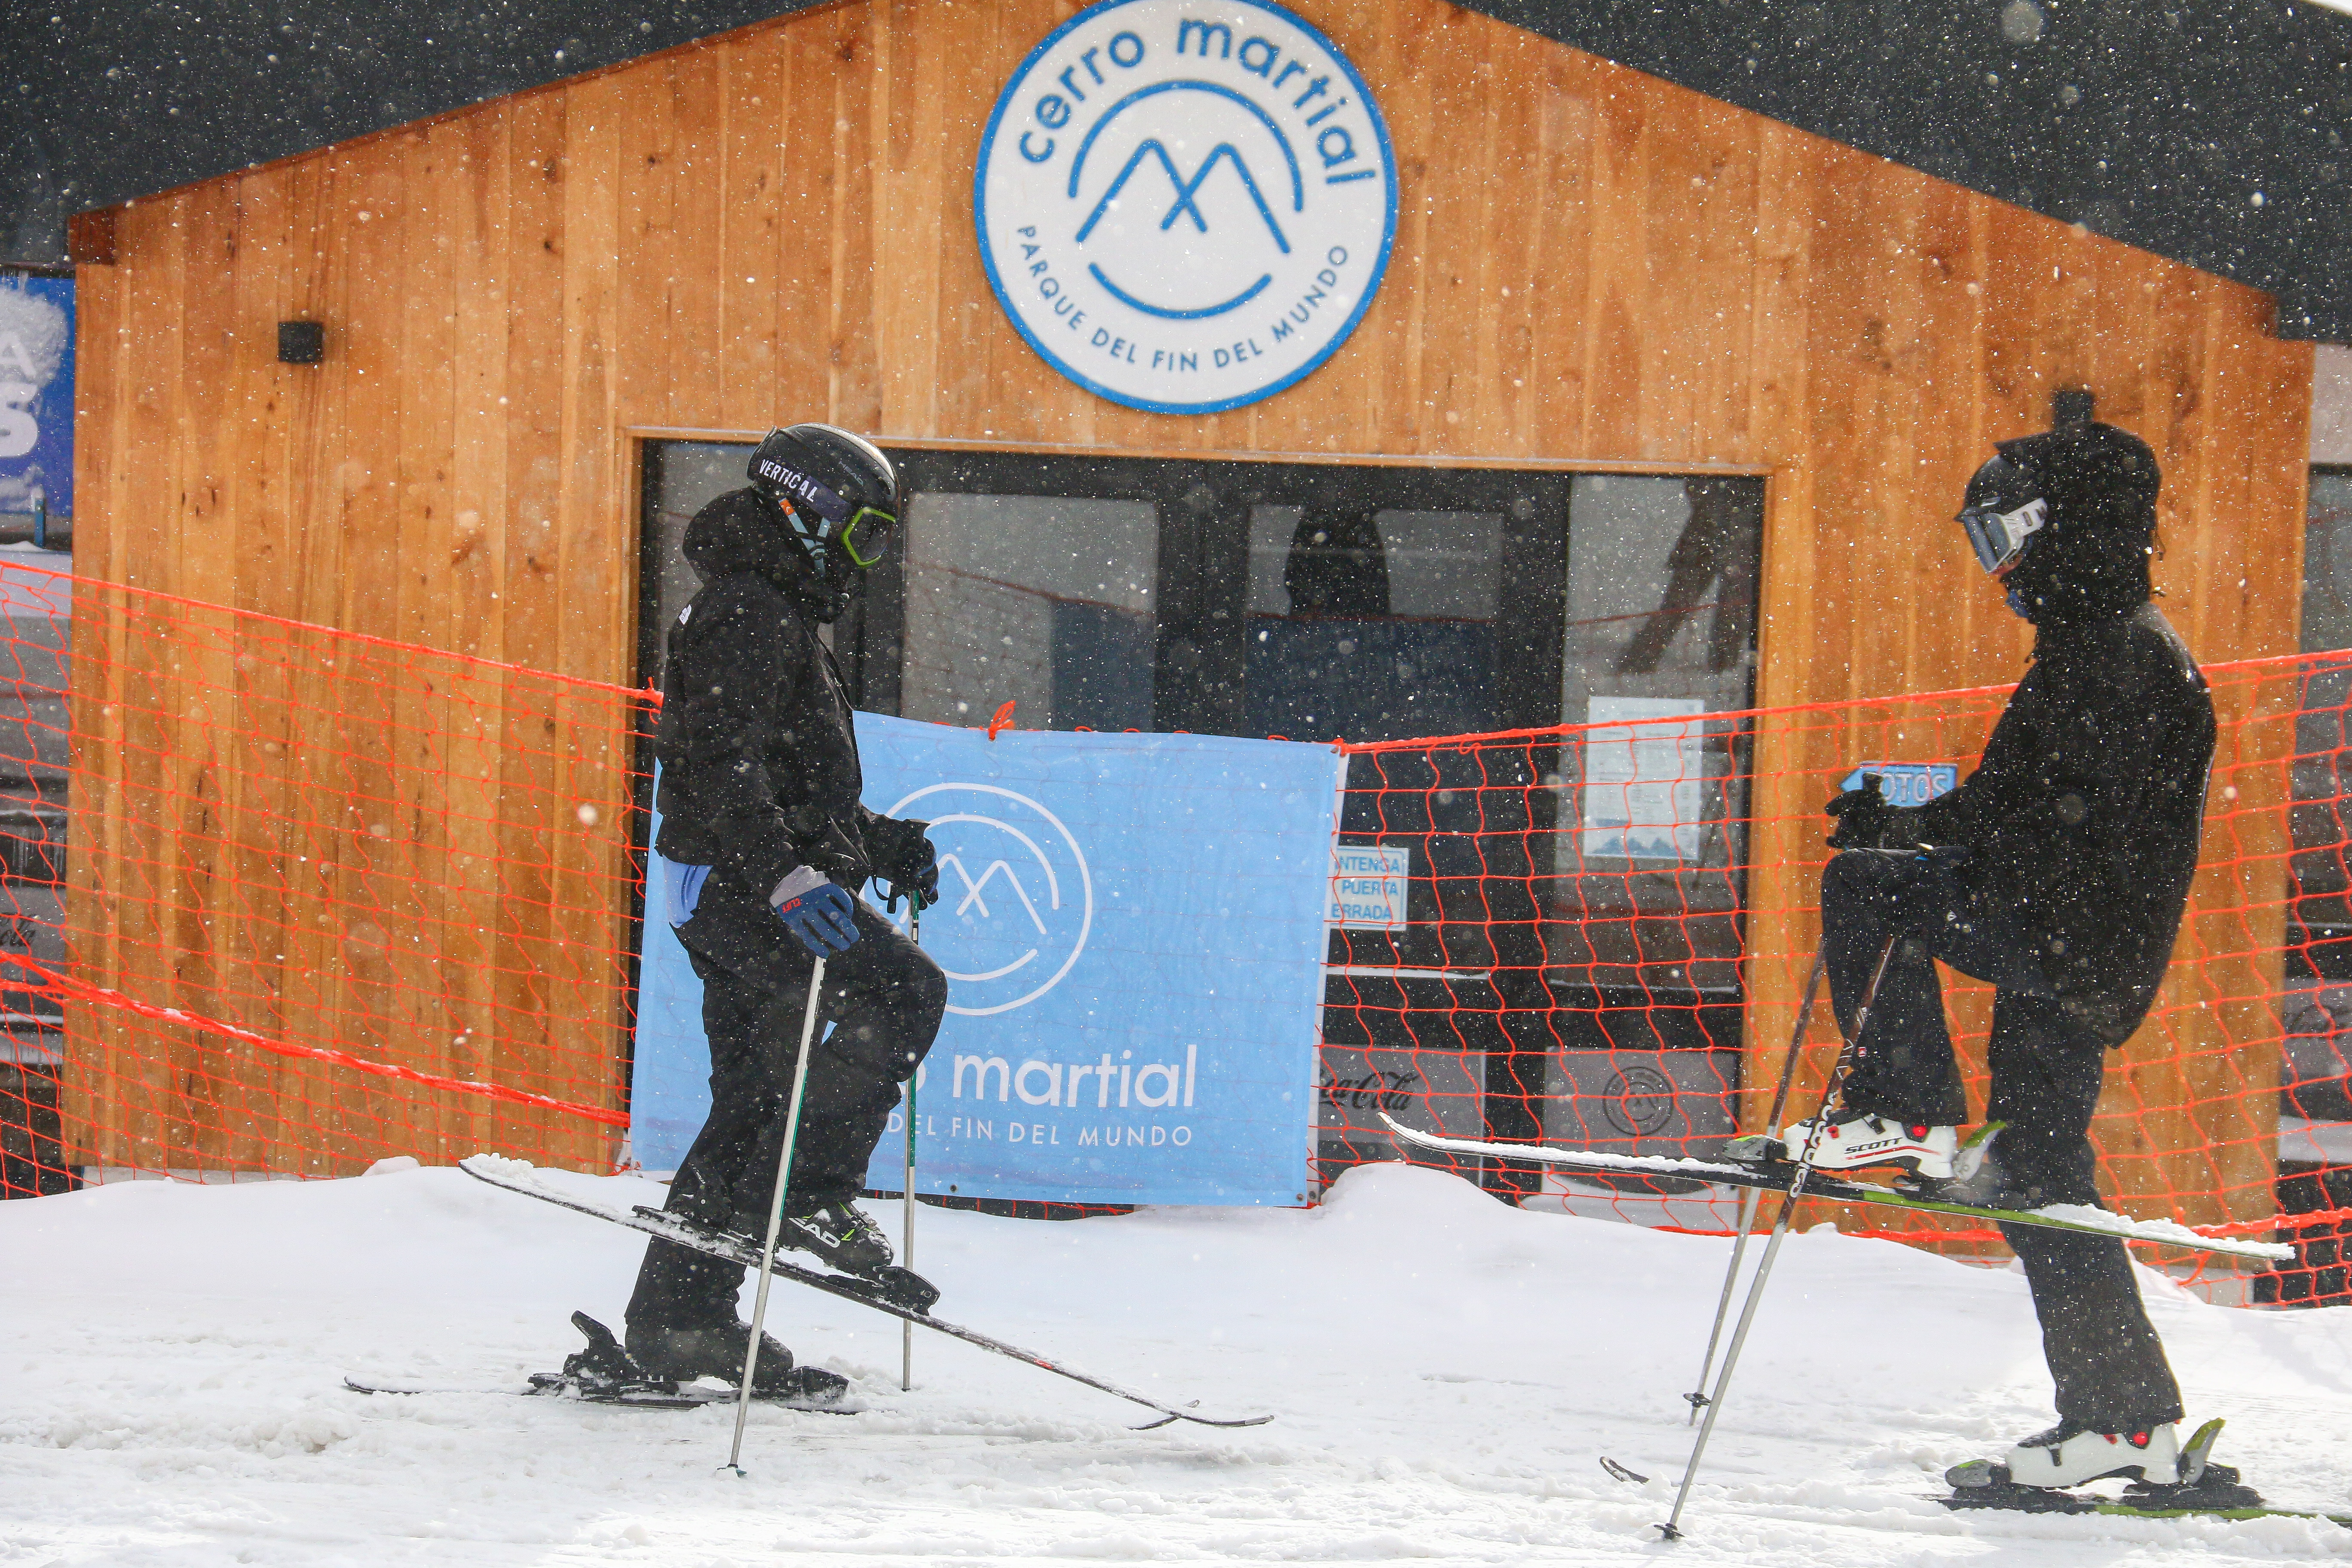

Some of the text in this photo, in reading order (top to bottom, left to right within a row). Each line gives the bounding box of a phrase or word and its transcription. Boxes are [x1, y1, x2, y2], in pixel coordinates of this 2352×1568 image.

[1019, 18, 1376, 184] cerro martial
[1017, 225, 1348, 371] PARQUE DEL FIN DEL MUNDO
[759, 459, 818, 503] VERTICAL
[1877, 772, 1948, 803] OTOS
[1342, 879, 1398, 895] PUERTA
[1332, 903, 1392, 919] ERRADA
[952, 1044, 1197, 1108] martial
[887, 1112, 1192, 1147] DEL FIN DEL MUNDO
[1844, 1137, 1903, 1154] SCOTT
[788, 1217, 841, 1248] EAD
